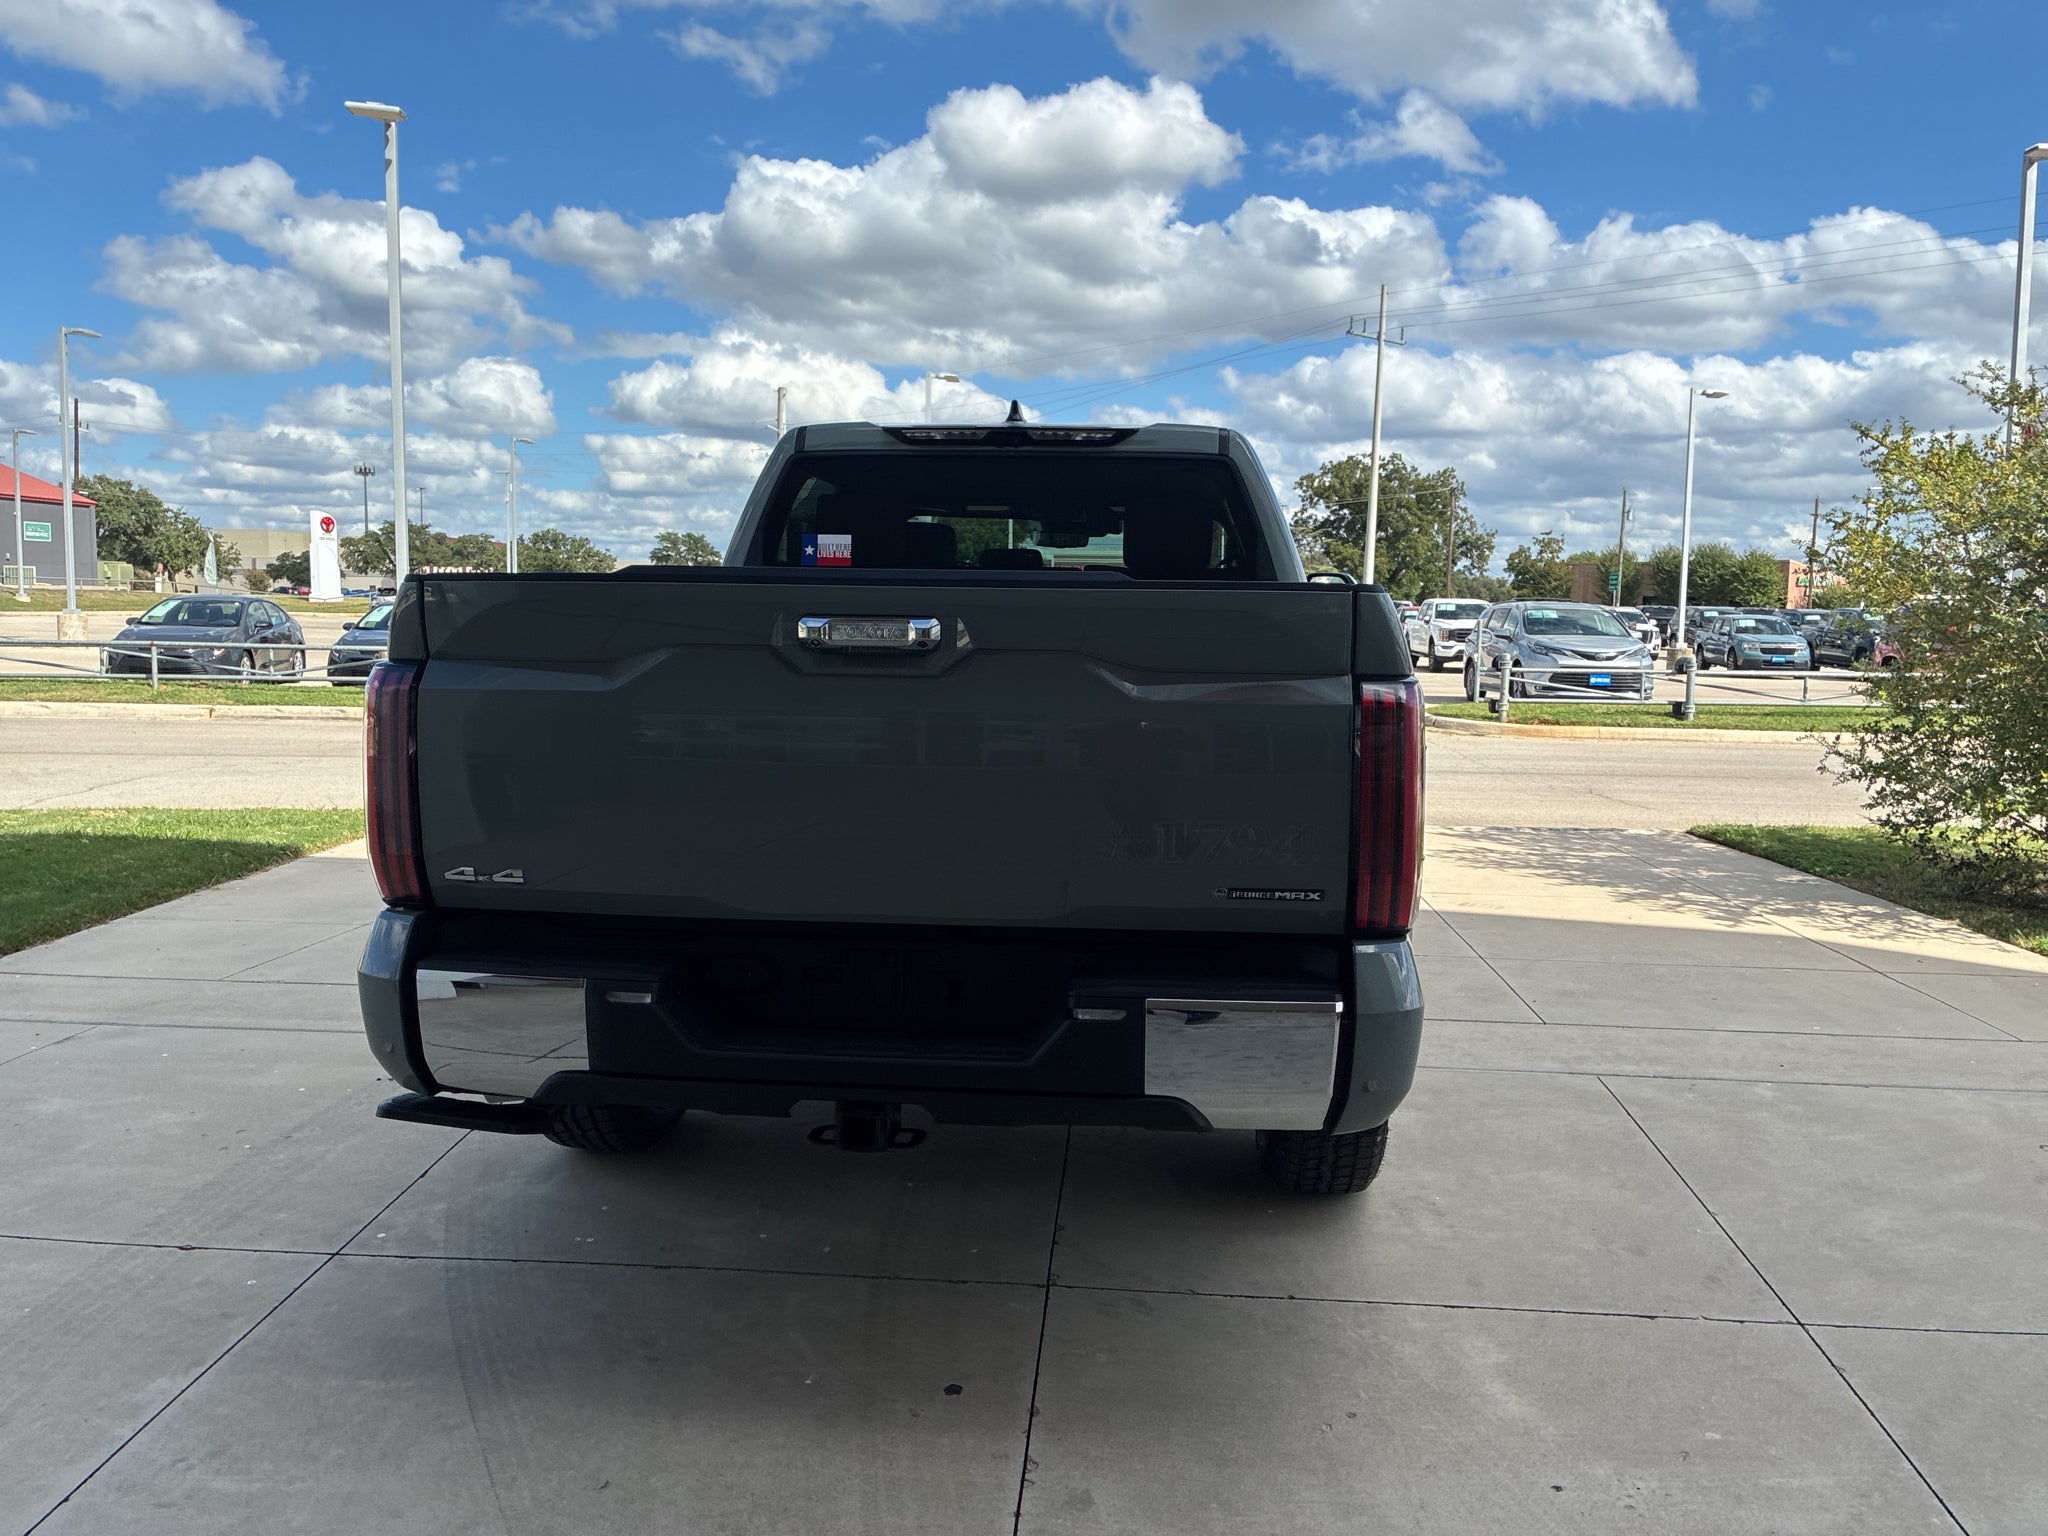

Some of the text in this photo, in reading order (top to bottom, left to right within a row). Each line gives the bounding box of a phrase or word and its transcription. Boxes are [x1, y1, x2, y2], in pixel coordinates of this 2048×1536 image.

[817, 550, 852, 558] LIVES HERE
[836, 623, 901, 640] TOYOTA
[1154, 822, 1316, 866] 1794
